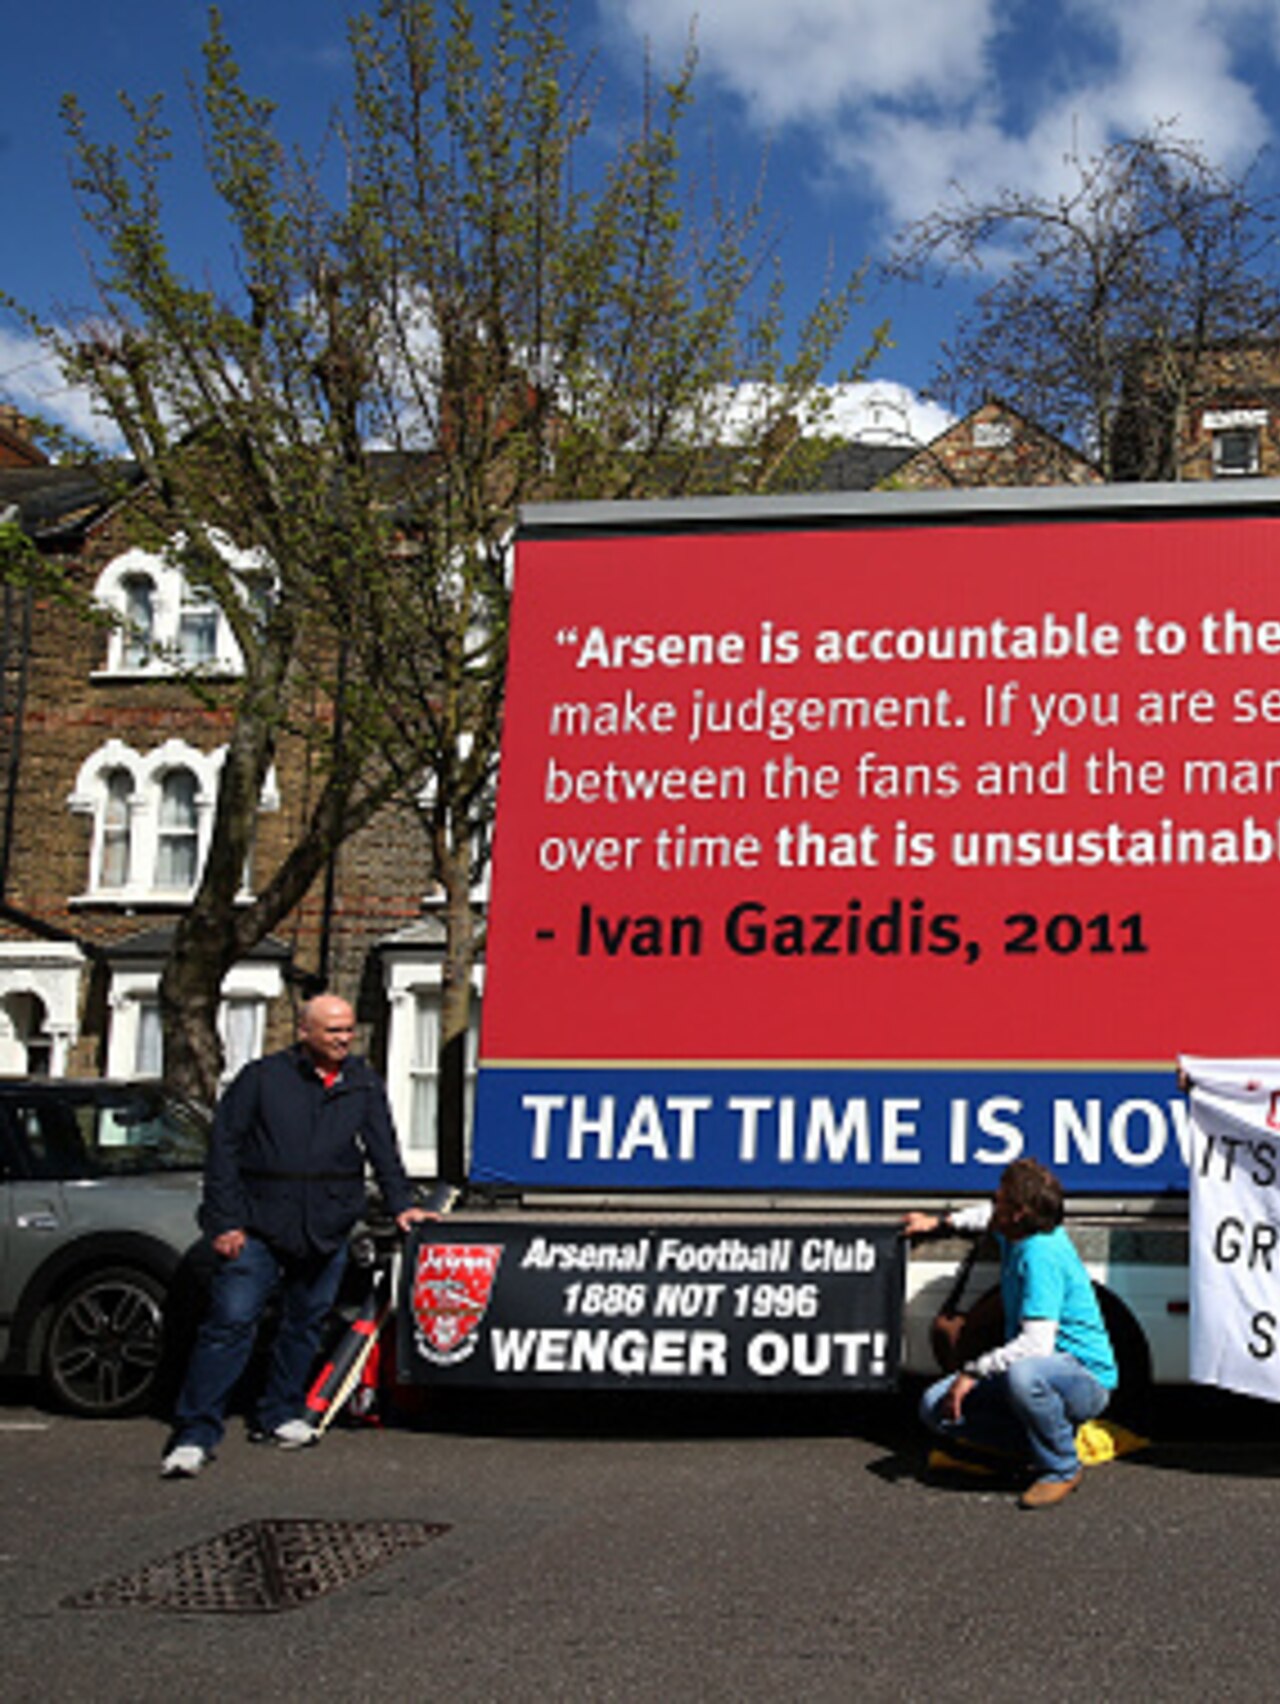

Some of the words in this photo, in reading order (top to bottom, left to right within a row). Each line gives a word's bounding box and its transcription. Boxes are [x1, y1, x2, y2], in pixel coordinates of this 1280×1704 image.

[556, 626, 745, 668] “Arsene
[760, 621, 800, 664] is
[815, 612, 1121, 663] accountable
[1135, 616, 1187, 655] to
[550, 690, 676, 735] make
[689, 688, 966, 741] judgement.
[986, 681, 1018, 727] If
[1030, 693, 1119, 736] you
[1137, 690, 1215, 724] are
[545, 759, 745, 803] between
[764, 755, 840, 799] the
[857, 752, 960, 798] fans
[976, 750, 1067, 795] and
[1085, 748, 1165, 795] the
[540, 837, 642, 871] over
[656, 824, 761, 870] time
[776, 822, 879, 867] that
[895, 820, 936, 867] is
[577, 903, 702, 957] Ivan
[725, 898, 981, 965] Gazidis,
[1004, 913, 1148, 955] 2011
[522, 1095, 712, 1161] THAT
[728, 1097, 921, 1164] TIME
[950, 1096, 1024, 1164] IS
[1201, 1133, 1278, 1187] IT'S
[520, 1237, 650, 1272] Arsenal
[656, 1238, 793, 1273] Football
[800, 1238, 876, 1273] Club
[564, 1281, 648, 1317] 1886
[653, 1282, 727, 1318] NOT
[733, 1283, 819, 1318] 1996
[490, 1328, 728, 1376] WENGER
[745, 1329, 887, 1376] OUT!
